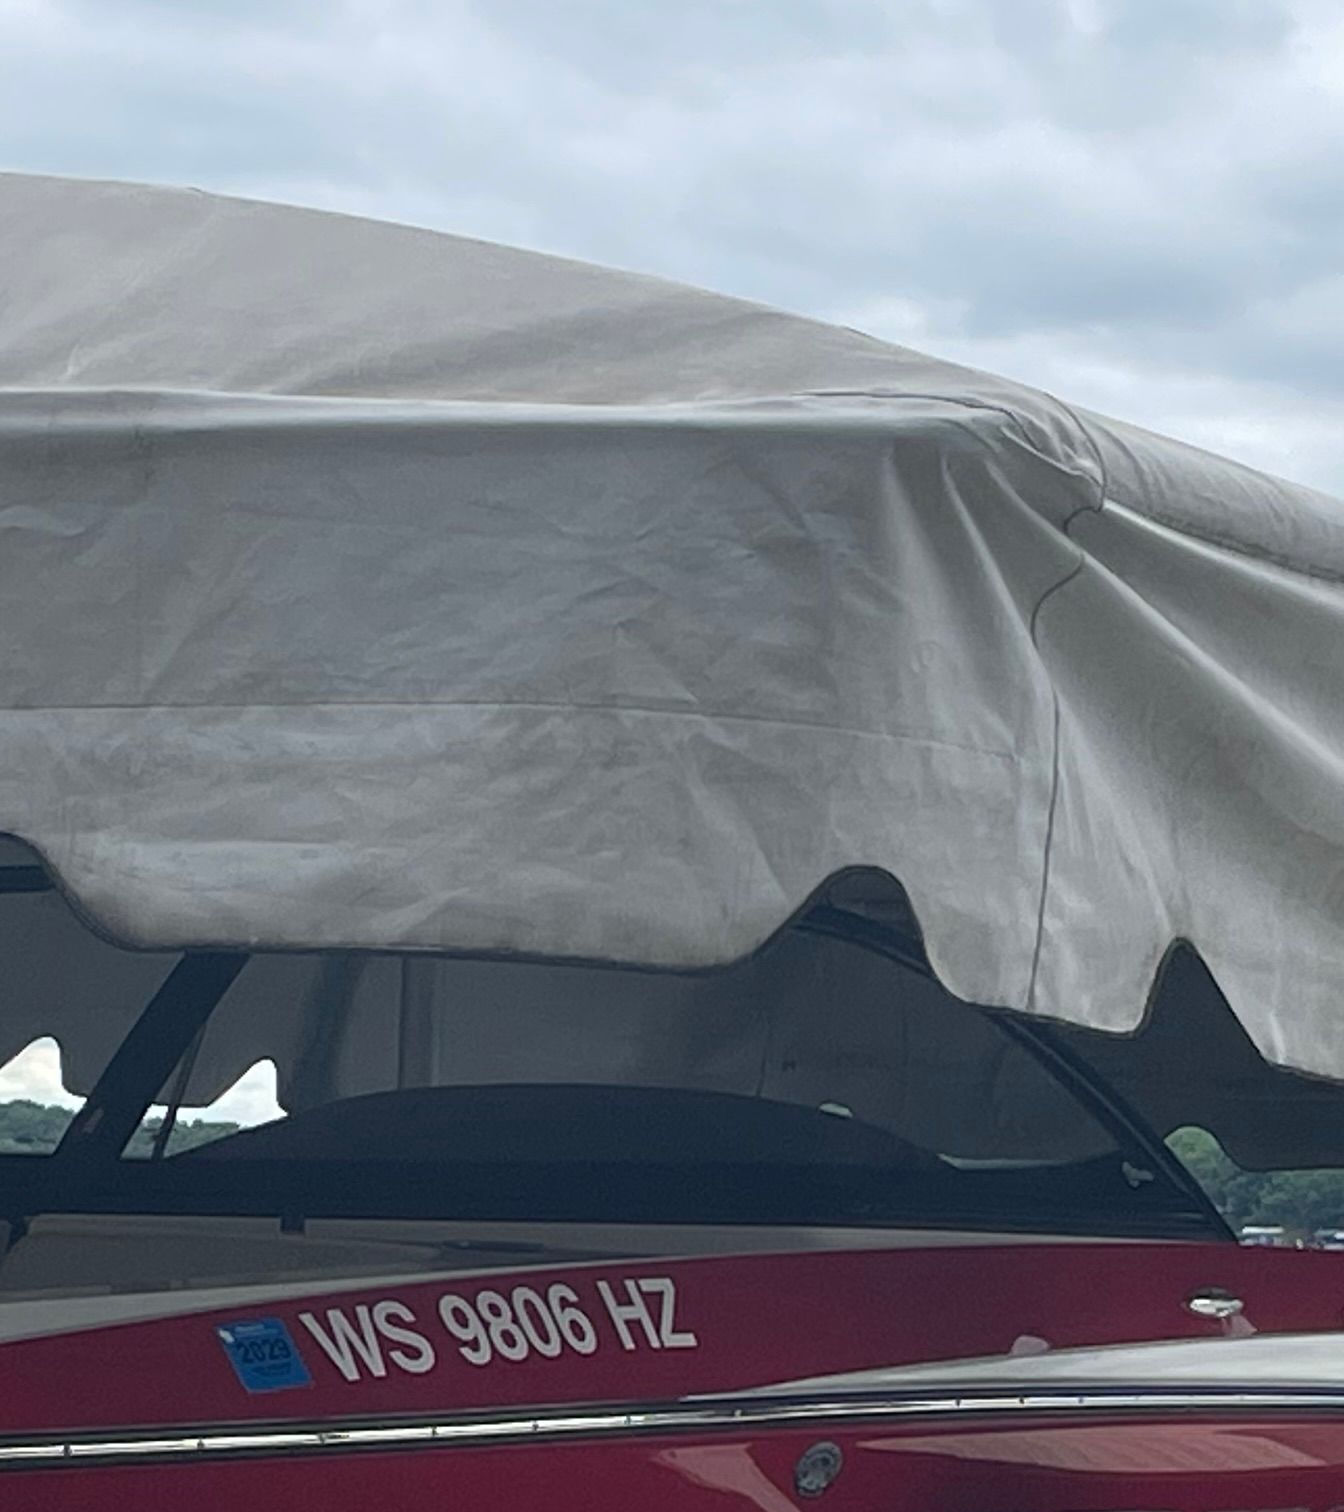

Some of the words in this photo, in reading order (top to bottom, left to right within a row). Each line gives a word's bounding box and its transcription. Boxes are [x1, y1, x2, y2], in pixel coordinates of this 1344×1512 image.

[298, 1300, 436, 1382] WS
[438, 1283, 598, 1366] 9806
[596, 1277, 699, 1351] HZ
